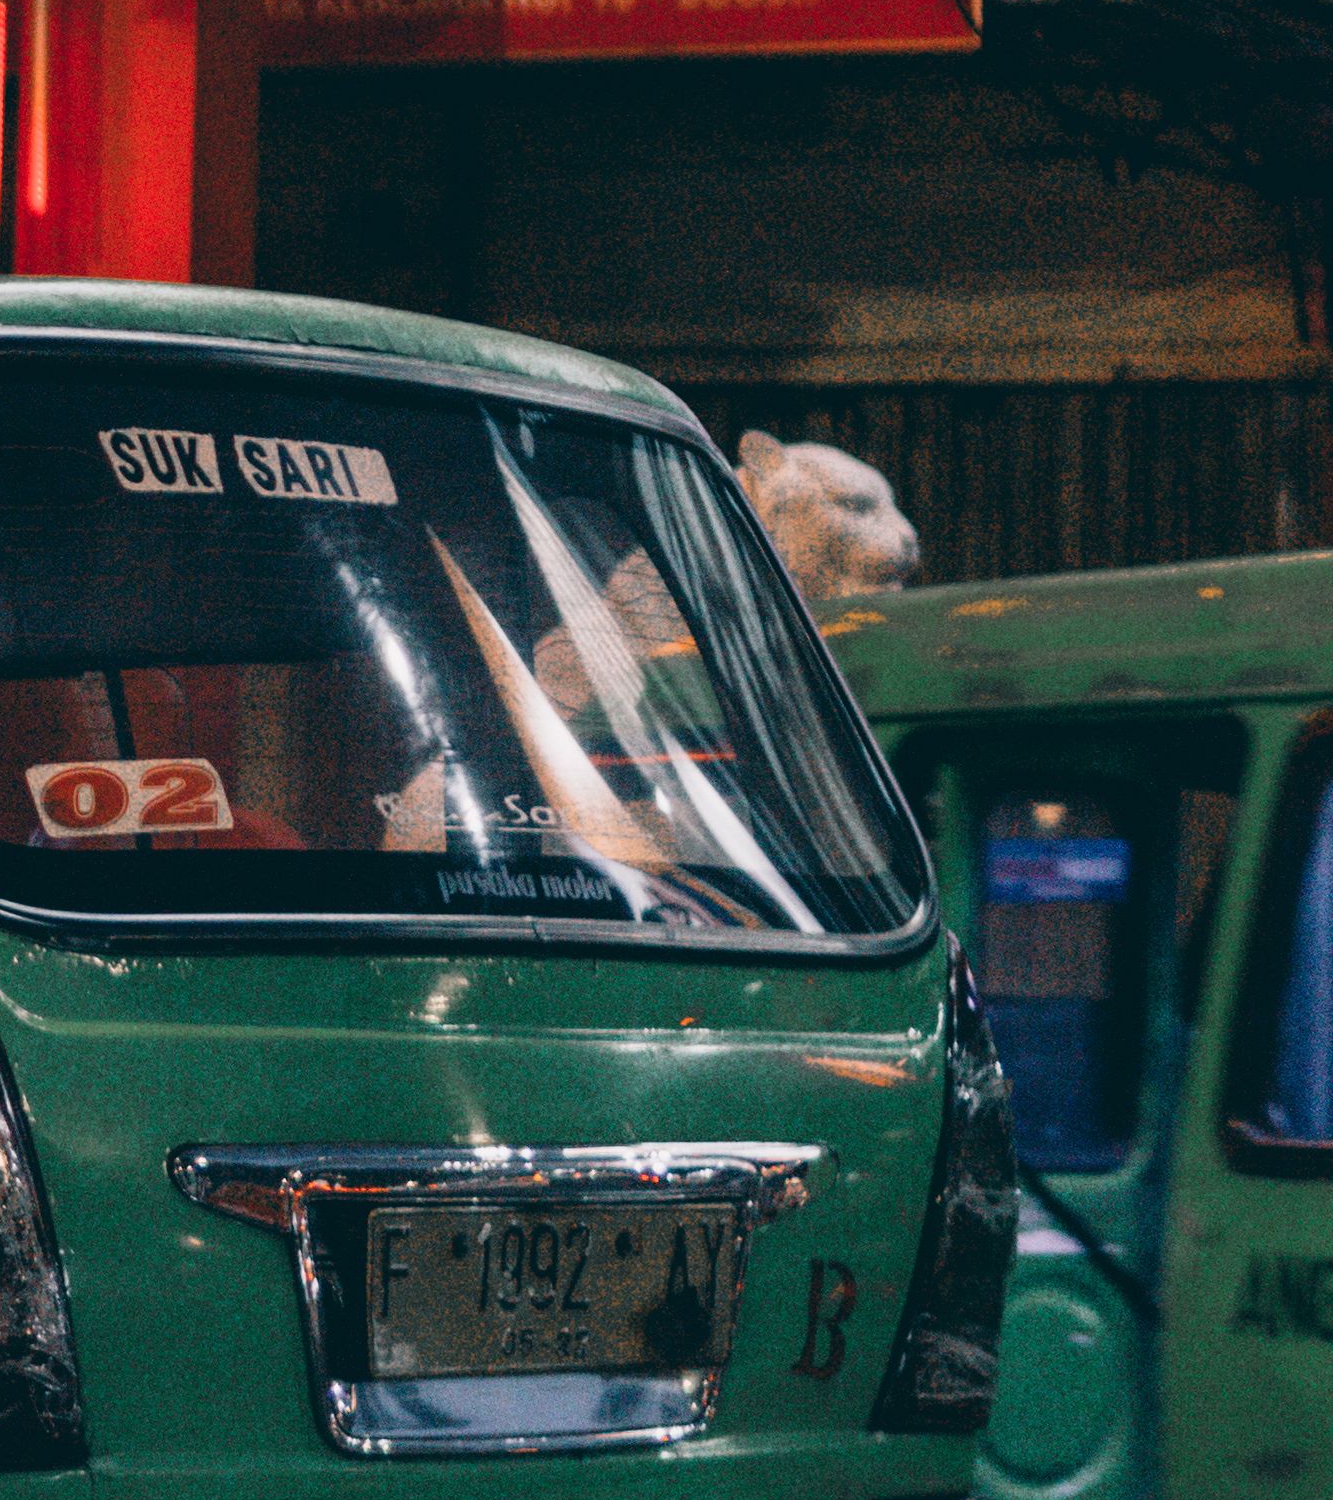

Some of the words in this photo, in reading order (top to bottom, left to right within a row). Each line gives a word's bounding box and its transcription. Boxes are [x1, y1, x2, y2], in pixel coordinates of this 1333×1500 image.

[109, 431, 215, 488] SUK
[241, 439, 361, 498] SARI
[40, 762, 219, 829] 02
[436, 865, 538, 904] pusaka
[540, 866, 614, 902] motor
[382, 1221, 411, 1319] F
[790, 1257, 858, 1380] B
